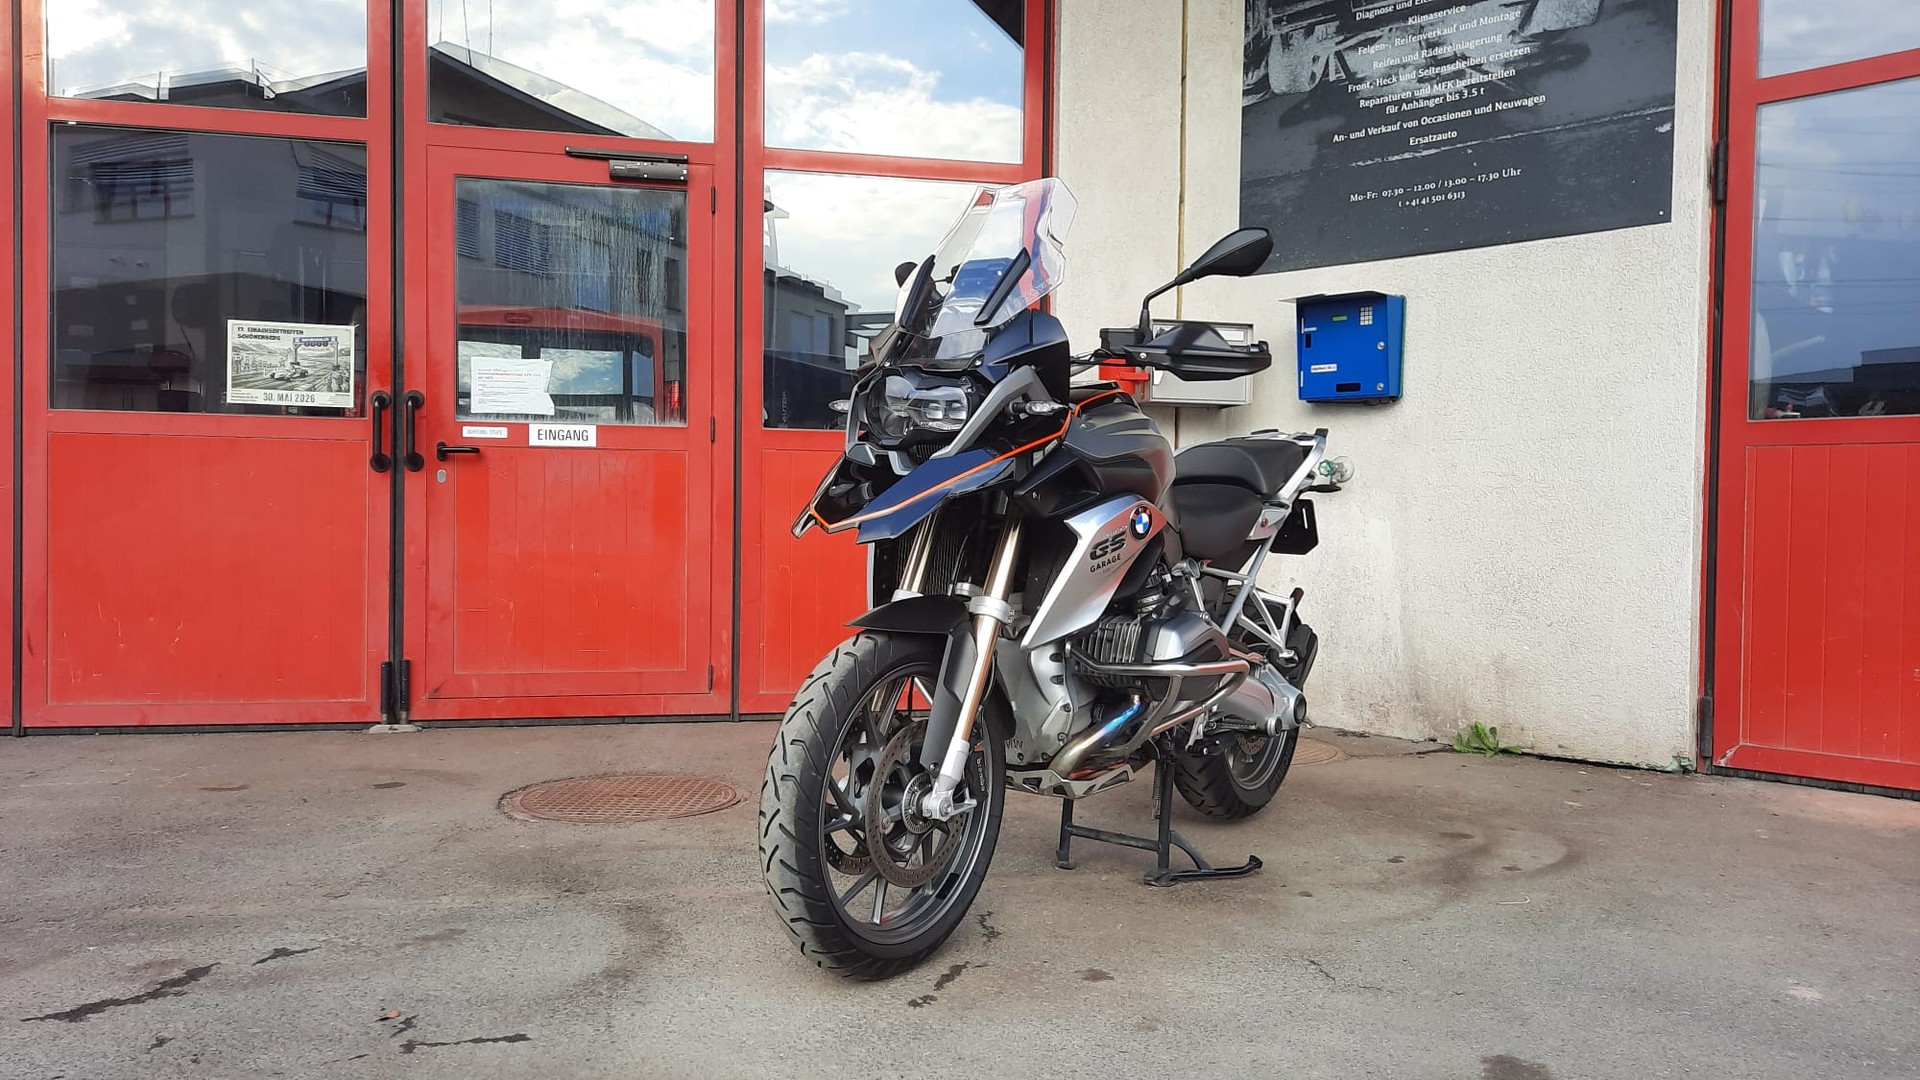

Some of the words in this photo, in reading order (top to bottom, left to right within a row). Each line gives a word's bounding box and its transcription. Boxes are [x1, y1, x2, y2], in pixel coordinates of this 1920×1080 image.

[1356, 4, 1394, 20] Diagnose
[1396, 0, 1413, 10] und
[1408, 4, 1466, 25] Klimaservice
[1358, 42, 1392, 55] Felgen-,
[1394, 24, 1457, 47] Reifenverkauf
[1459, 19, 1477, 31] und
[1479, 9, 1521, 26] Montage
[1373, 56, 1400, 70] Reifen
[1402, 51, 1419, 62] und
[1421, 33, 1503, 58] Rädereinlagerung
[1376, 74, 1398, 87] Heck
[1400, 71, 1417, 81] und
[1418, 55, 1487, 78] Seitenscheiben
[1489, 46, 1531, 62] ersetzen
[1359, 89, 1412, 109] Reparaturen
[1414, 85, 1431, 96] und
[1433, 80, 1455, 92] MFK
[1456, 68, 1516, 87] bereitstellen
[1386, 105, 1399, 115] für
[1400, 95, 1445, 112] Anhänger
[1446, 92, 1460, 103] bis
[1462, 88, 1479, 99] 3.5
[1332, 134, 1349, 143] An-
[1350, 128, 1366, 139] und
[1367, 121, 1402, 136] Verkauf
[1403, 119, 1419, 129] von
[1420, 108, 1473, 126] Occasionen
[1474, 103, 1493, 115] und
[1495, 93, 1546, 111] Neuwagen
[1409, 130, 1458, 146] Ersatzauto
[1350, 191, 1379, 203] Mo-Fr:
[1382, 186, 1404, 198] 07.30
[1414, 182, 1436, 193] 12.00
[1444, 176, 1467, 188] 13.00
[1478, 171, 1500, 183] 17.30
[1502, 166, 1522, 178] Uhr
[1405, 197, 1420, 208] +41
[1421, 196, 1430, 207] 41
[1431, 192, 1445, 203] 501
[1447, 190, 1466, 202] 6313
[262, 392, 276, 402] 30.
[276, 393, 294, 404] MAI
[294, 394, 316, 404] 2026
[536, 427, 590, 442] EINGANG
[1089, 530, 1127, 561] GS
[1089, 553, 1122, 573] GARAGE
